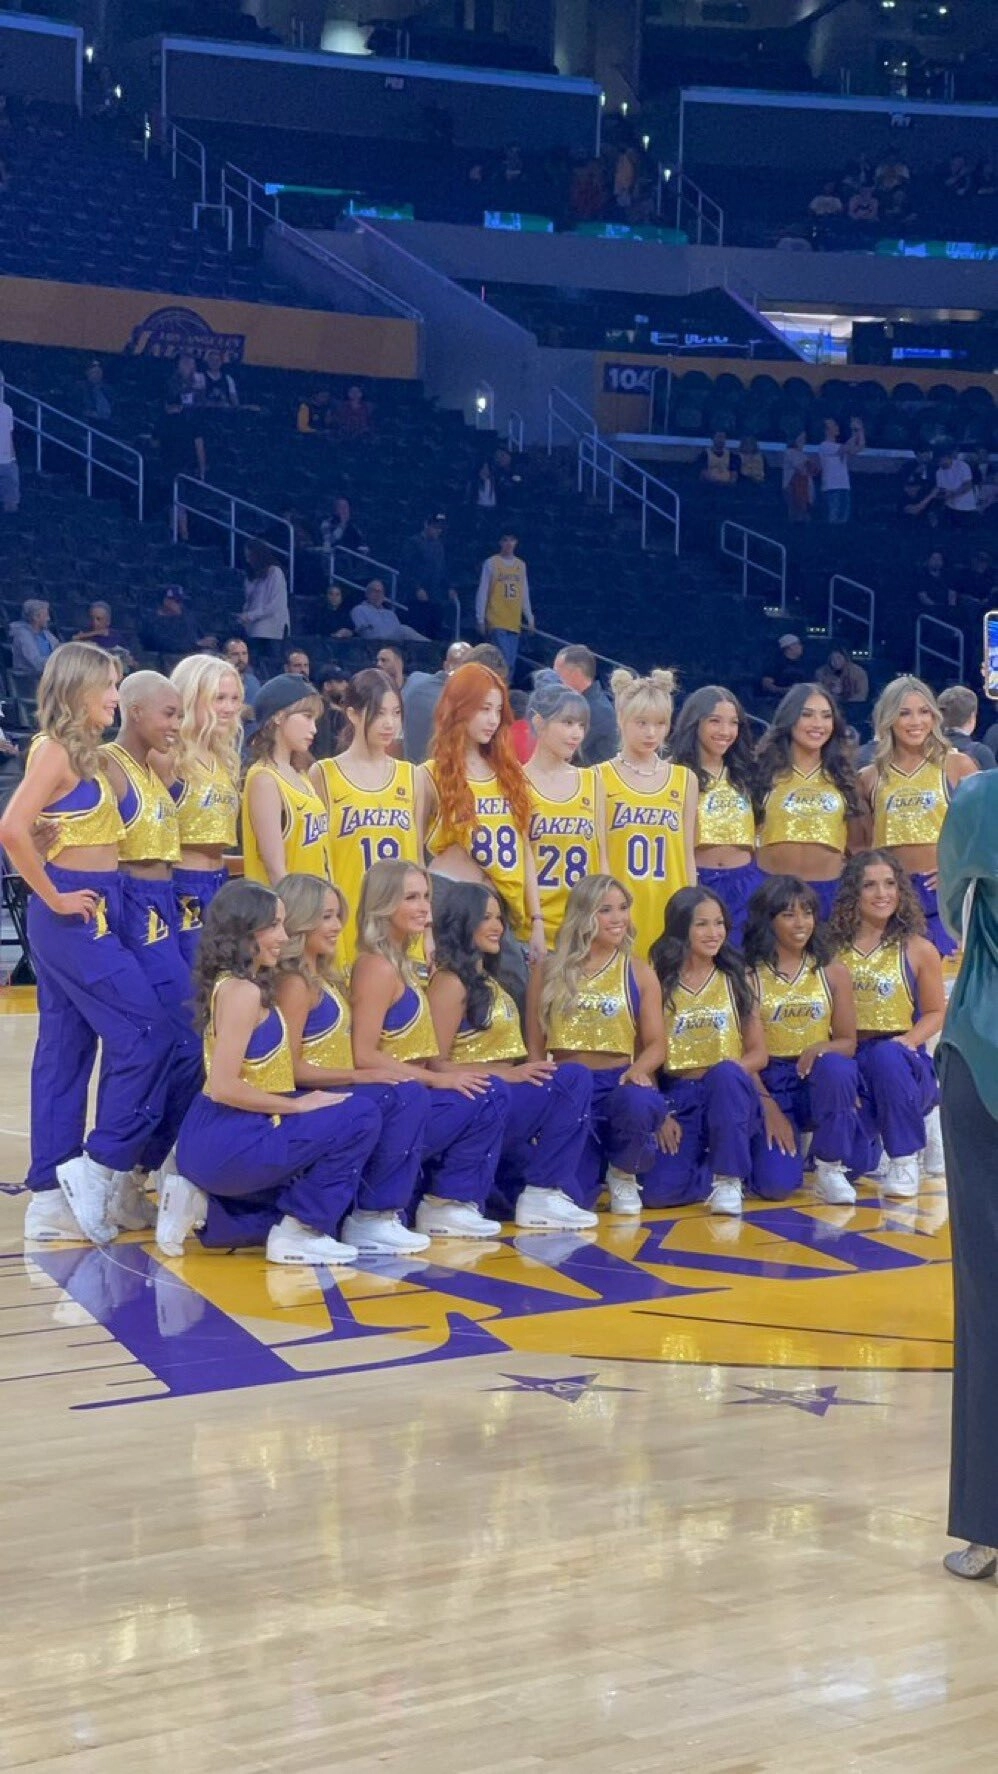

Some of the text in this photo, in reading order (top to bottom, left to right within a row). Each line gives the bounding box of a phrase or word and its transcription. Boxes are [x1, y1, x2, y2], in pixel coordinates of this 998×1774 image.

[608, 367, 652, 390] 104
[337, 806, 410, 838] LAKERS
[529, 813, 594, 841] LAKERS
[610, 802, 680, 831] LAKERS
[471, 825, 517, 870] 88
[627, 834, 666, 878] 01
[537, 845, 588, 888] 28
